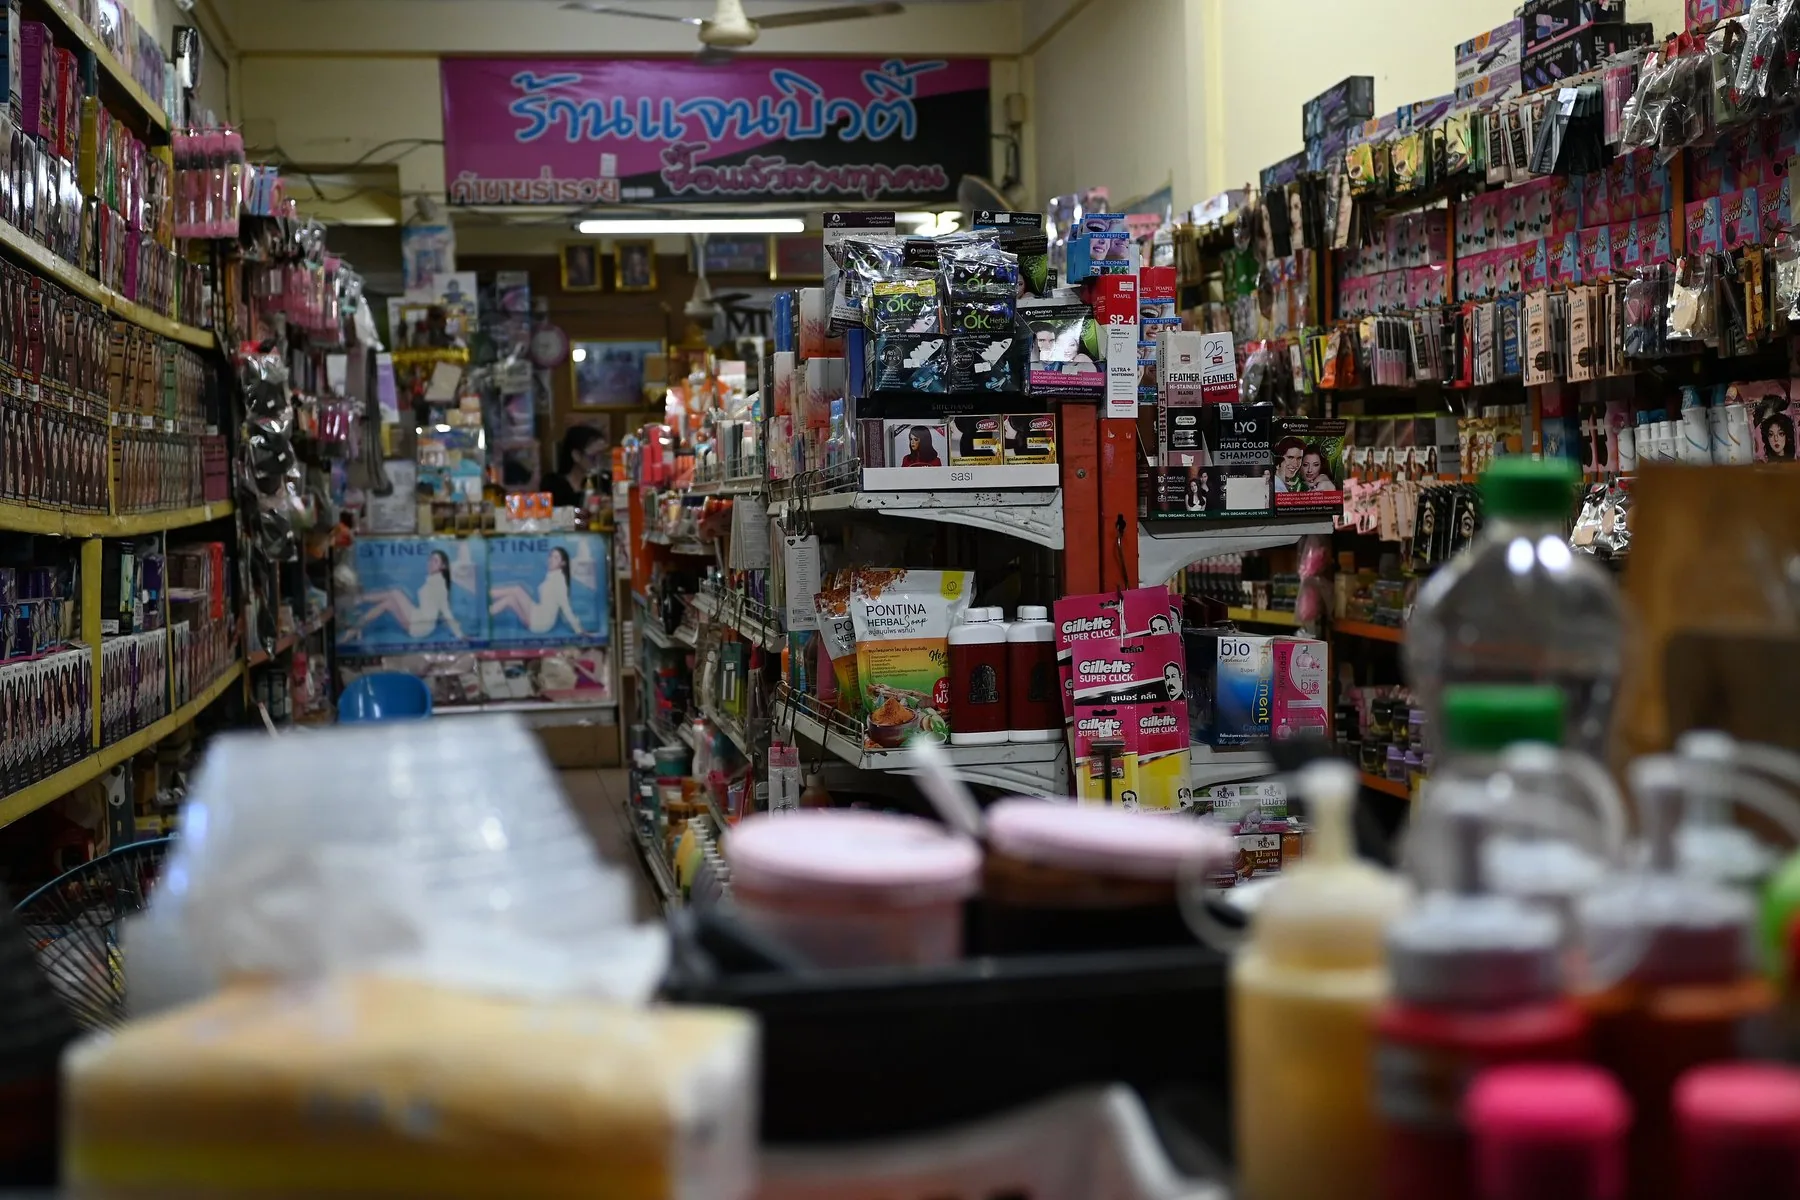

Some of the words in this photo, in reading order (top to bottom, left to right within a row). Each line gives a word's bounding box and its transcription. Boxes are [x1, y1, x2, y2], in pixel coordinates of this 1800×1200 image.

[510, 58, 948, 142] ร้านแจนบิวตี้
[886, 295, 914, 312] OK
[963, 310, 990, 329] OK
[1109, 314, 1136, 325] SP-4
[1169, 373, 1200, 382] FEATHER
[1202, 372, 1235, 384] FEATHER
[1220, 404, 1231, 412] 01
[1158, 391, 1167, 444] FEATHER
[1234, 421, 1257, 433] LYO
[1241, 441, 1269, 449] COLOR
[1219, 451, 1269, 460] SHAMPOO
[866, 603, 927, 617] PONTINA
[867, 617, 904, 628] HERBAL
[904, 615, 928, 629] Soap
[1061, 617, 1112, 634] Gillette
[1062, 633, 1089, 643] SUPER
[1090, 630, 1115, 639] CLICK
[1220, 639, 1250, 656] bio
[1079, 660, 1132, 674] Gillette
[1079, 674, 1107, 683] SUPER
[1108, 673, 1134, 682] CLICK
[1300, 679, 1320, 690] bio
[1111, 692, 1138, 703] ซูเปอร์
[1140, 716, 1177, 727] Gillette
[1140, 727, 1160, 735] SUPER
[1160, 725, 1179, 733] CLICK
[1217, 789, 1235, 799] Reya
[1257, 839, 1275, 849] Reya
